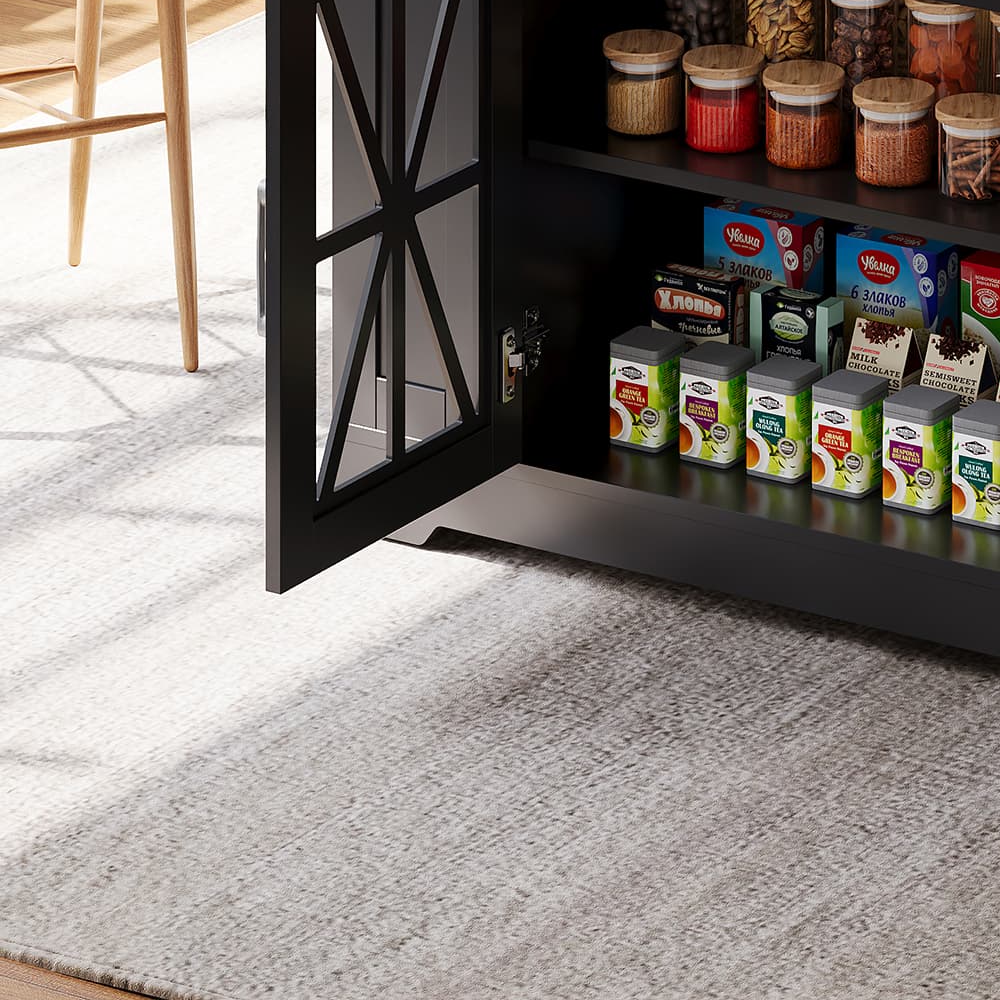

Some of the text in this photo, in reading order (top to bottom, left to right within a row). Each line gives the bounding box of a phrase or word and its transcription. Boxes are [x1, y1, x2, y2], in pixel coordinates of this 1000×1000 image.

[861, 255, 896, 276] Увелка
[850, 285, 907, 309] 6 злаков
[850, 352, 879, 365] MILK
[848, 361, 901, 378] CHOCOLATE
[924, 369, 978, 386] SEMISWEET
[922, 378, 976, 395] CHOCOLATE
